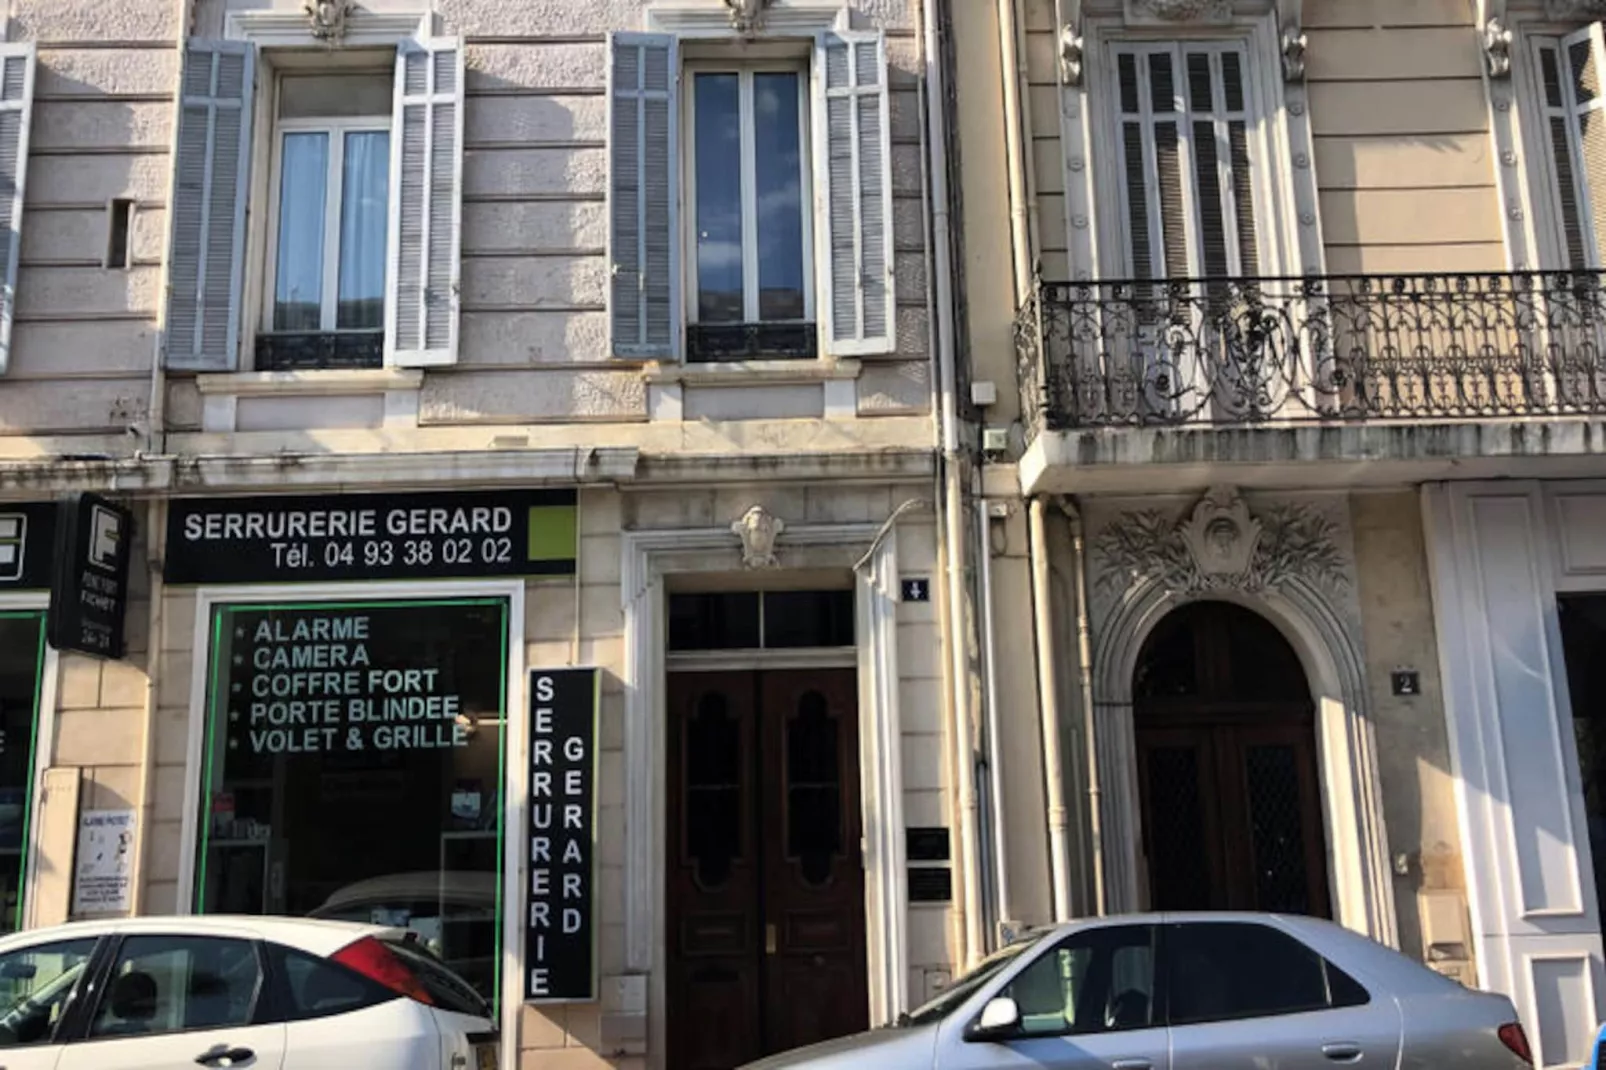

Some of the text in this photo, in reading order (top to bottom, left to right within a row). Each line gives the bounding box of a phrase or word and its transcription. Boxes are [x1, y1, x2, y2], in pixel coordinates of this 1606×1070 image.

[184, 506, 513, 541] SERRURERIE GERARD
[271, 538, 512, 569] Tél. 04 93 38 02 02
[253, 616, 370, 642] ALARME
[253, 644, 370, 670] CAMERA
[252, 668, 438, 698] COFFRE FORT
[1400, 675, 1412, 693] 2
[250, 695, 459, 725] PORTE BLINDEE
[250, 724, 468, 752] VOLET & GRILLE
[530, 676, 554, 995] SERRURERIE
[562, 736, 584, 934] GERARD
